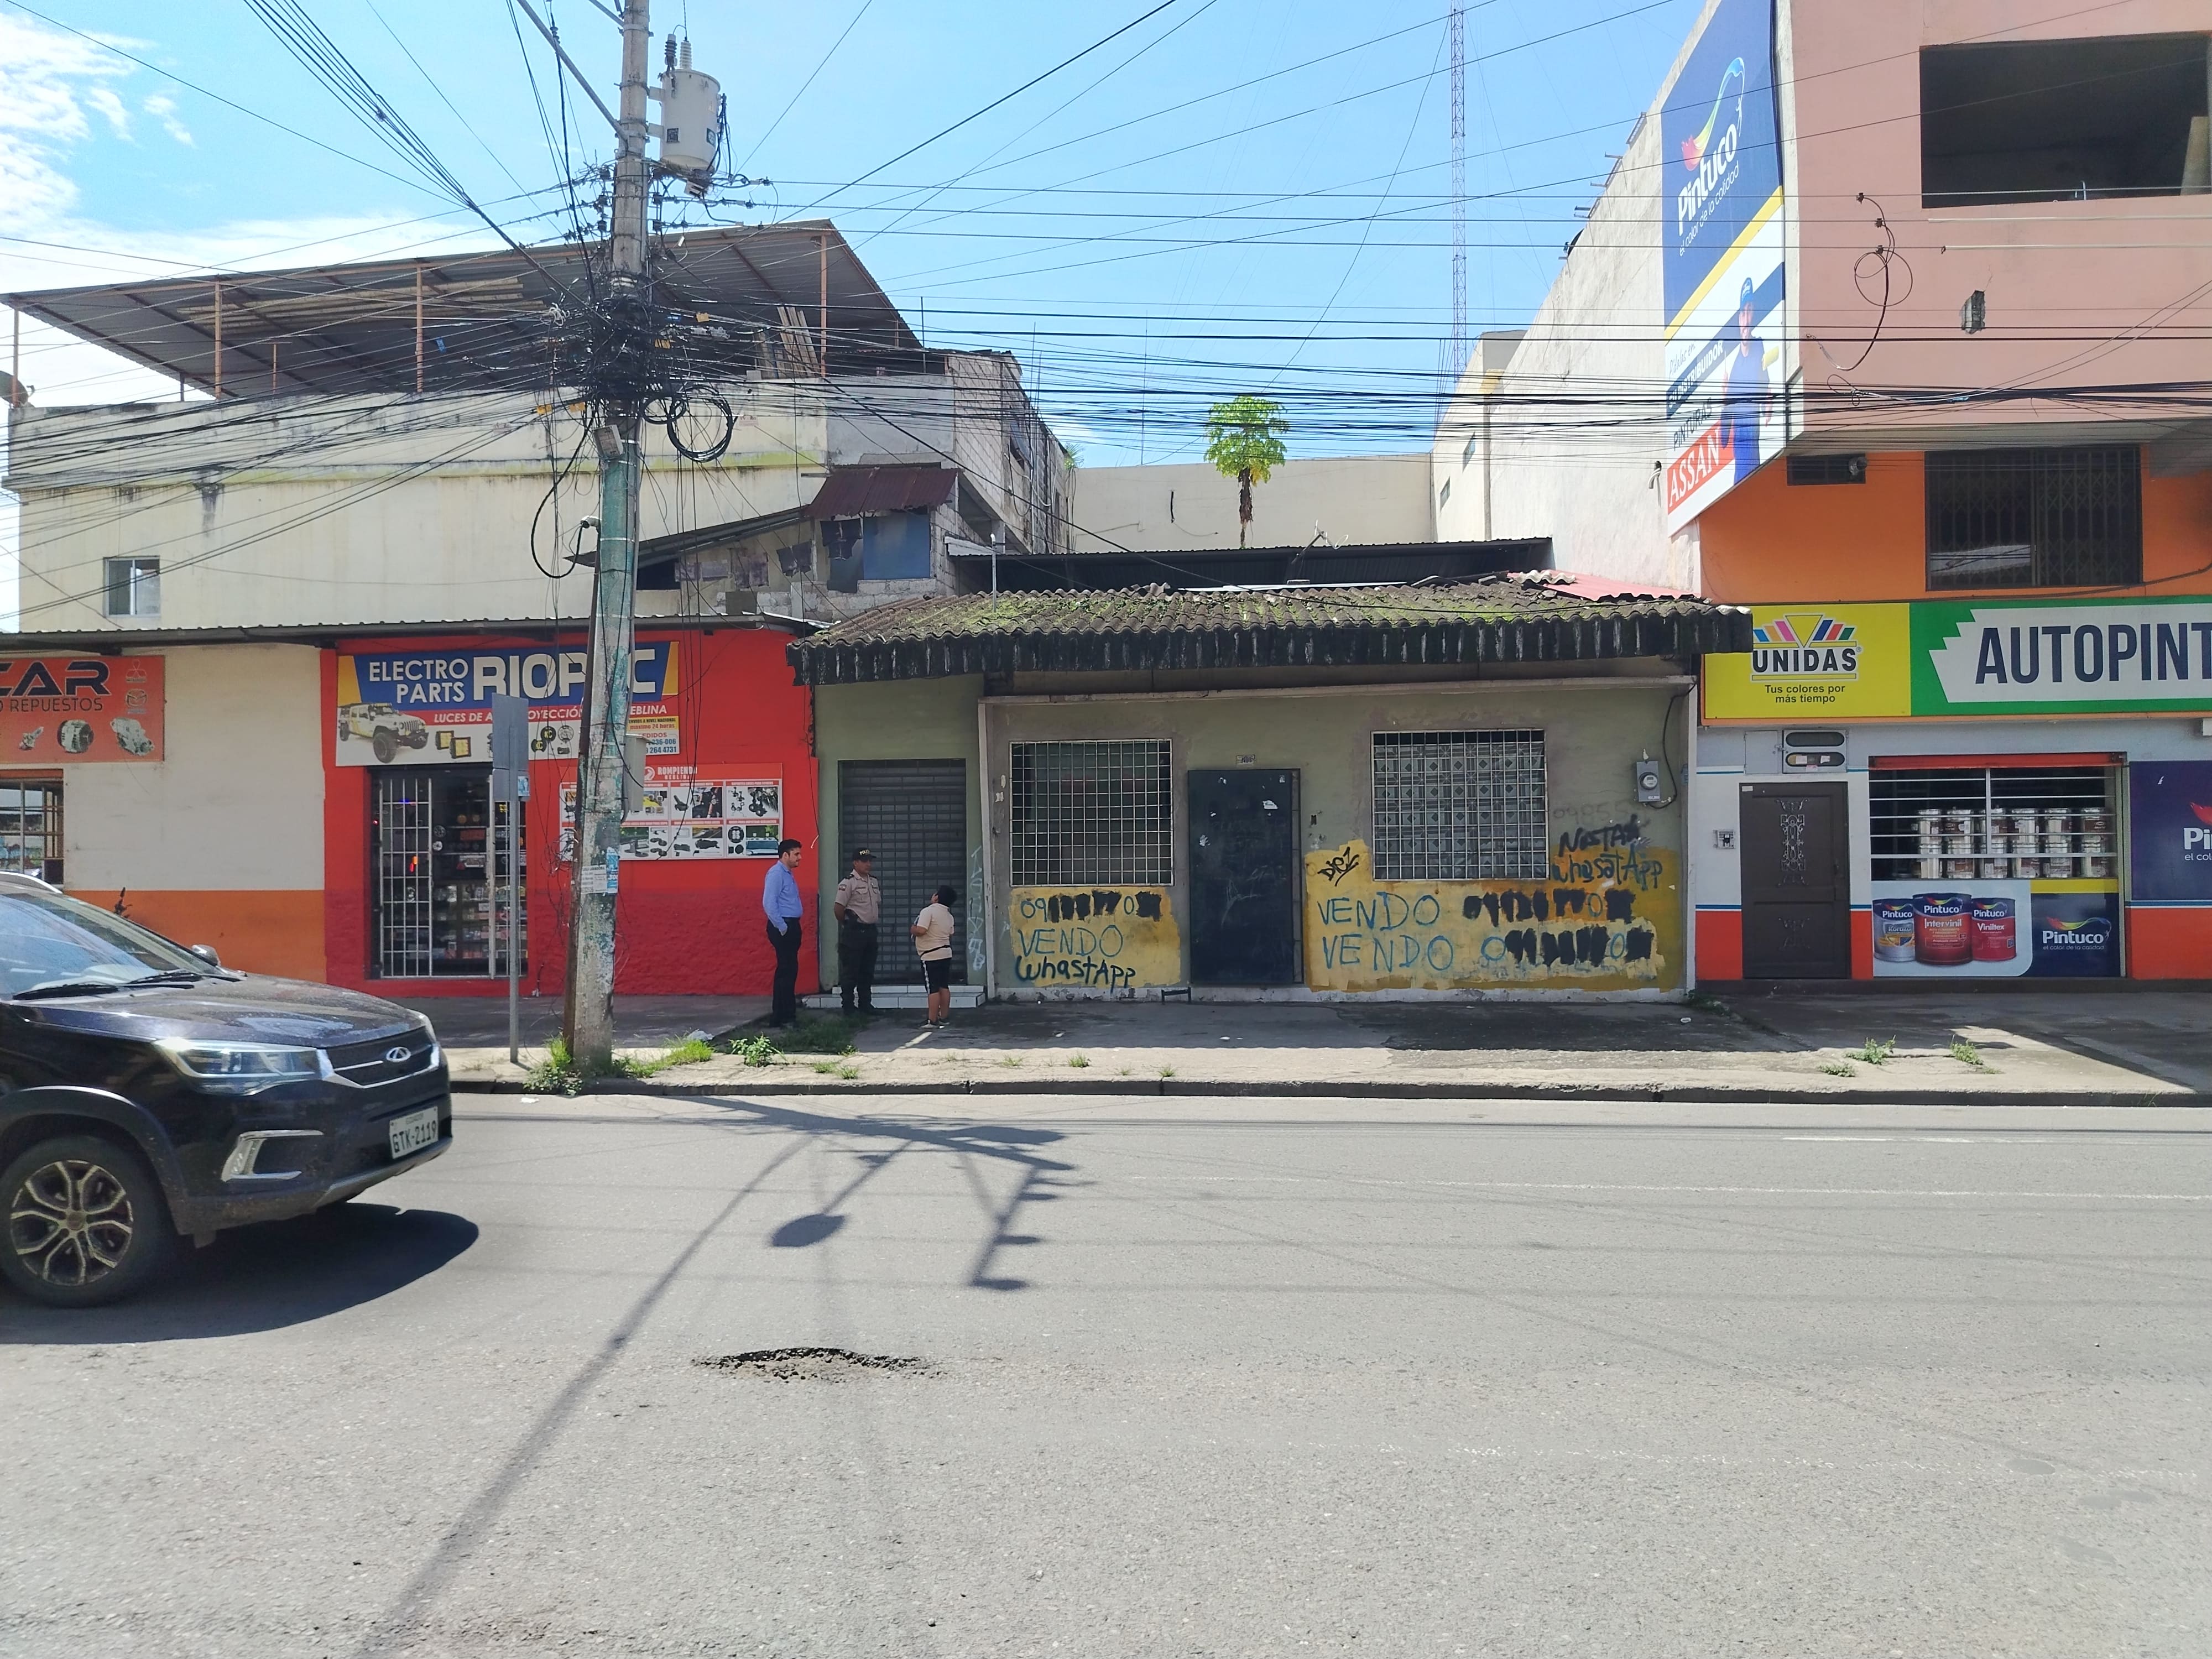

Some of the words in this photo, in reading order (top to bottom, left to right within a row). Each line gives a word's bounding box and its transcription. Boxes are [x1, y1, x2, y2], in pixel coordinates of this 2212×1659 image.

[1678, 123, 1737, 237] Pintuco
[1685, 221, 1699, 247] color
[1699, 210, 1708, 227] de
[1708, 200, 1714, 216] la
[1715, 159, 1739, 205] calidad
[1677, 340, 1723, 401] DISTRIBUIDOR
[1673, 397, 1712, 452] PINTURAS
[1669, 427, 1720, 507] ASSAN
[1752, 648, 1856, 673] UNIDAS
[1975, 623, 2212, 684] AUTOPINT
[369, 658, 469, 682] ELECTRO
[473, 649, 656, 701] RIOPC
[397, 681, 466, 704] PARTS
[1765, 685, 1783, 693] Tus
[1786, 685, 1824, 693] colores
[1828, 685, 1845, 694] por
[1776, 694, 1797, 703] más
[1800, 694, 1835, 704] tiempo
[10, 697, 103, 712] REPUESTOS
[630, 705, 667, 715] EBLINA
[434, 713, 466, 723] LUCES
[469, 712, 483, 722] DE
[2184, 852, 2193, 860] el
[2196, 852, 2212, 860] col
[1317, 891, 1440, 931] VENDO
[1924, 905, 1960, 914] Pintuco
[1973, 909, 2005, 918] Pintuco
[1924, 918, 1962, 929] Intervinil
[1977, 922, 2005, 931] Viniltex
[1018, 925, 1123, 958] VENDO
[2042, 930, 2104, 944] Pintuco
[1322, 933, 1453, 973] VENDO
[392, 1120, 437, 1154] GTK-2119
